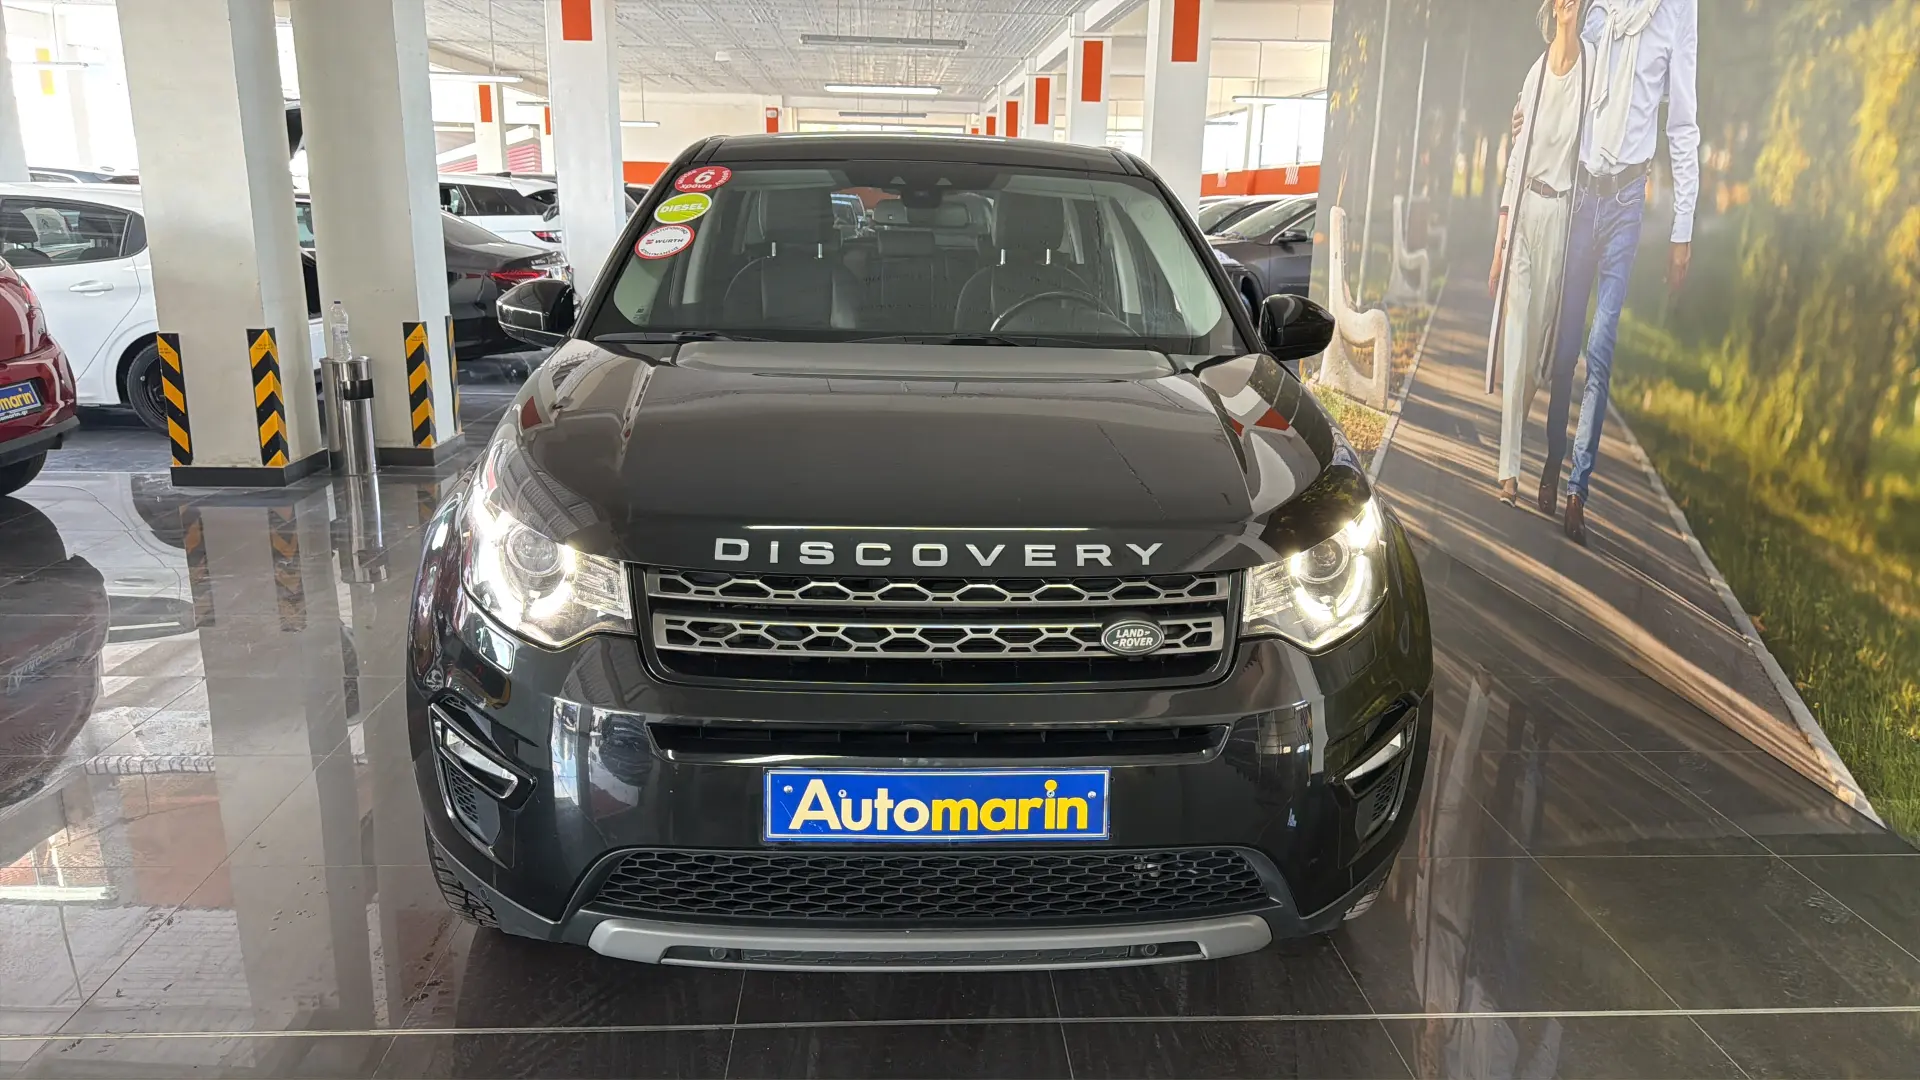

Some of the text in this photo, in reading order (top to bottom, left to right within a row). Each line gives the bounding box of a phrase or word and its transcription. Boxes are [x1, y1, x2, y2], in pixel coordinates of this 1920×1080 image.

[694, 171, 715, 184] 6
[660, 202, 705, 213] DIESEL
[714, 537, 1163, 567] DISCOVERY
[1116, 628, 1145, 638] LAND
[1118, 637, 1154, 647] ROVER
[788, 778, 1088, 831] Automarin
